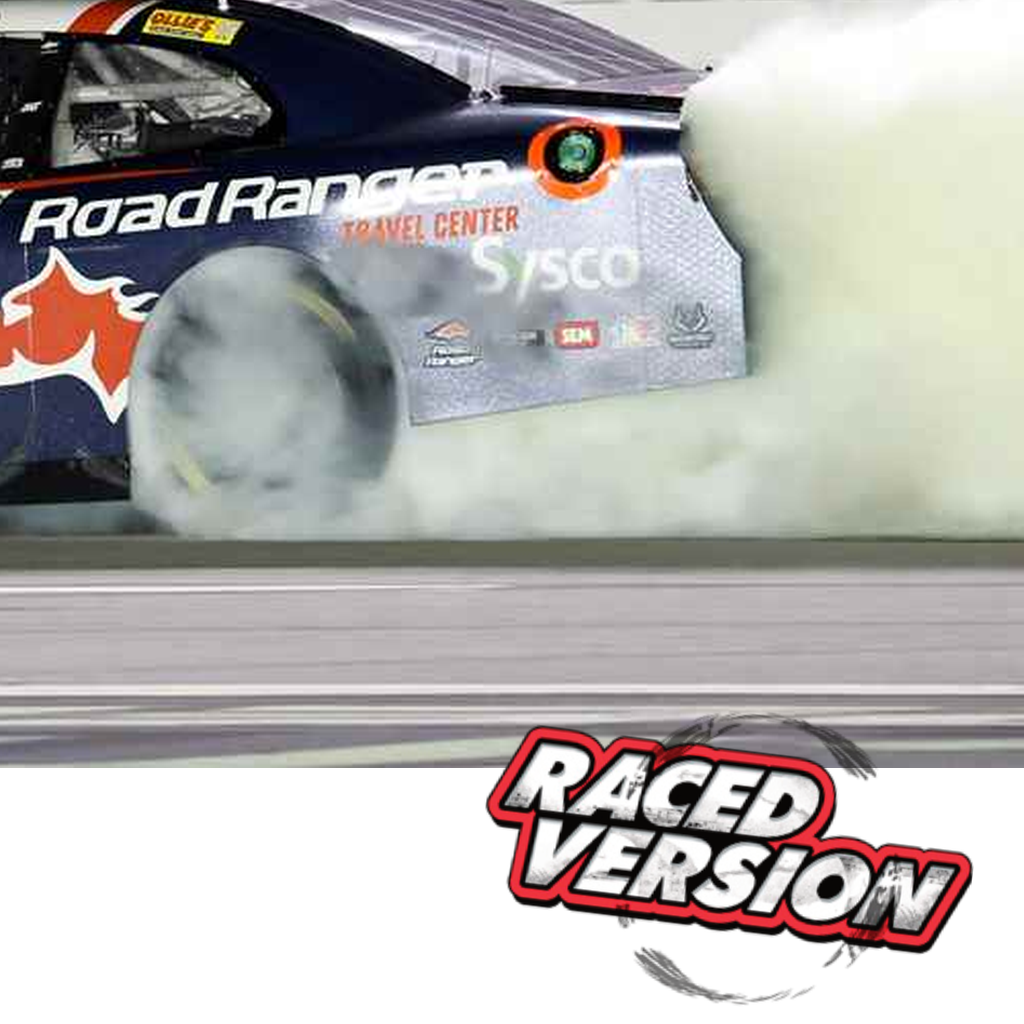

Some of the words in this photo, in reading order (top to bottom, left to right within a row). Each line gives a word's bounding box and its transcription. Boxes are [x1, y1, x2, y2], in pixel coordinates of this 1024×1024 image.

[19, 180, 220, 244] Road
[217, 160, 510, 223] Ranger
[341, 214, 426, 247] TRAVEL
[434, 206, 519, 240] CENTER
